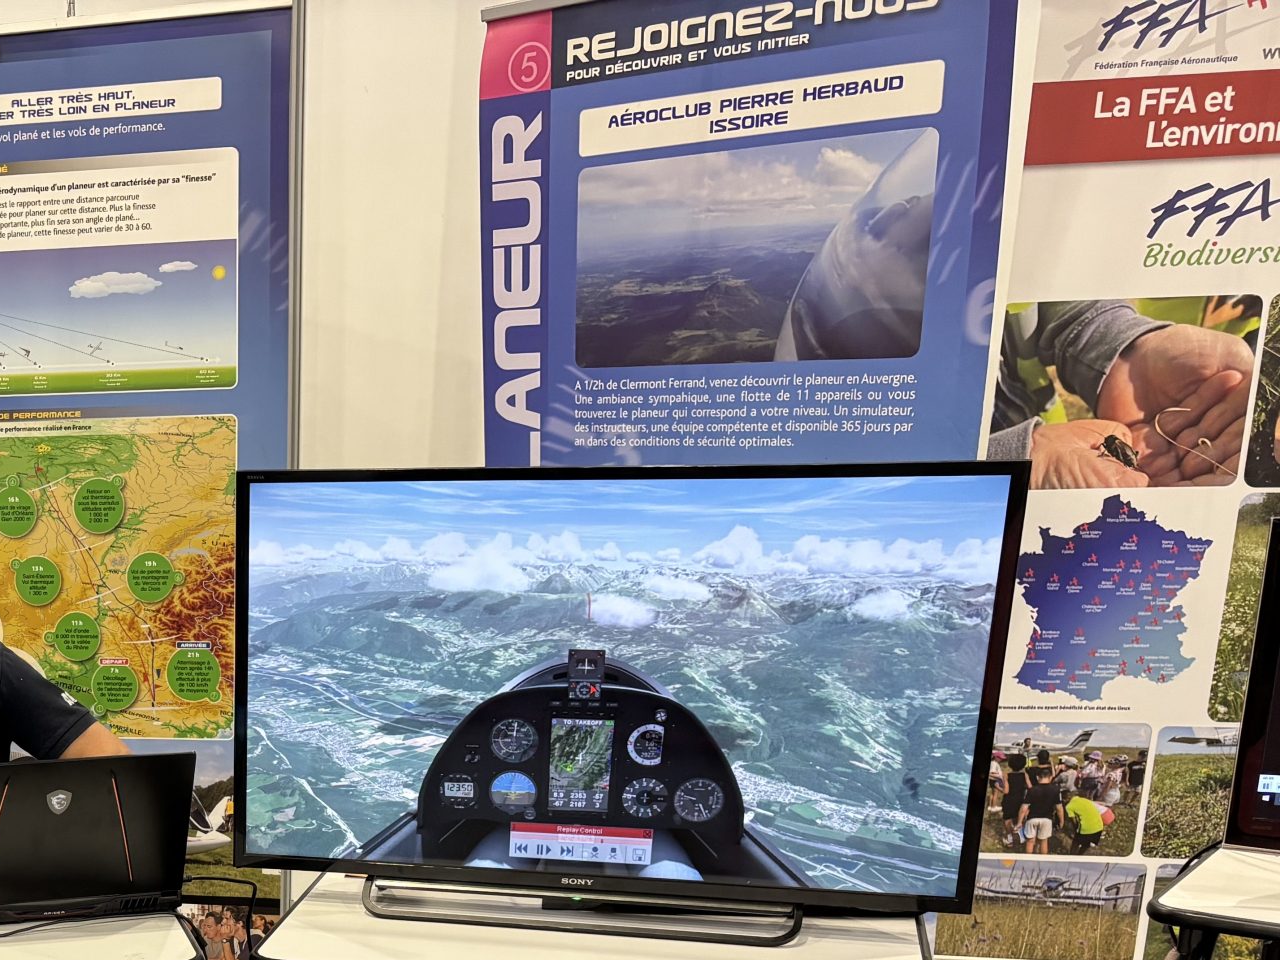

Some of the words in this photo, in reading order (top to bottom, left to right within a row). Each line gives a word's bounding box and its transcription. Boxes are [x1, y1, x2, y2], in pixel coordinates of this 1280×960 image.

[1097, 0, 1244, 51] FFA
[520, 51, 539, 83] 5
[566, 67, 600, 81] POUR
[605, 54, 682, 74] DÉCOUVRIR
[688, 49, 707, 61] ET
[713, 42, 751, 57] VOUS
[757, 33, 809, 50] INITIER
[1094, 61, 1138, 70] Fédération
[1140, 58, 1179, 67] Française
[1180, 55, 1238, 64] Aéronautique
[11, 96, 53, 108] ALLER
[58, 93, 92, 104] TRÈS
[19, 106, 53, 118] TRÈS
[58, 105, 86, 115] LOIN
[92, 103, 109, 112] EN
[115, 98, 175, 110] PLANEUR
[608, 102, 711, 127] AÉROCLUB
[719, 90, 793, 112] PIERRE
[803, 76, 903, 101] HERBAUD
[1094, 91, 1130, 118] La
[1139, 87, 1196, 116] FFA
[1204, 86, 1235, 111] et
[13, 130, 38, 143] plané
[40, 130, 50, 139] et
[52, 128, 65, 138] les
[67, 126, 86, 136] vols
[89, 125, 100, 135] de
[103, 123, 165, 137] performance.
[709, 111, 789, 134] ISSOIRE
[67, 182, 95, 192] planeur
[110, 178, 155, 187] caractérisée
[157, 178, 170, 186] par
[1146, 178, 1280, 239] FFA
[575, 380, 581, 391] A
[584, 379, 604, 390] 1/2h
[606, 379, 618, 390] de
[620, 379, 666, 389] Clermont
[668, 377, 707, 388] Ferrand,
[709, 378, 738, 387] venez
[740, 375, 791, 386] découvrir
[793, 373, 802, 385] le
[805, 373, 844, 388] planeur
[846, 375, 859, 384] en
[861, 373, 917, 386] Auvergne.
[561, 877, 593, 885] SONY
